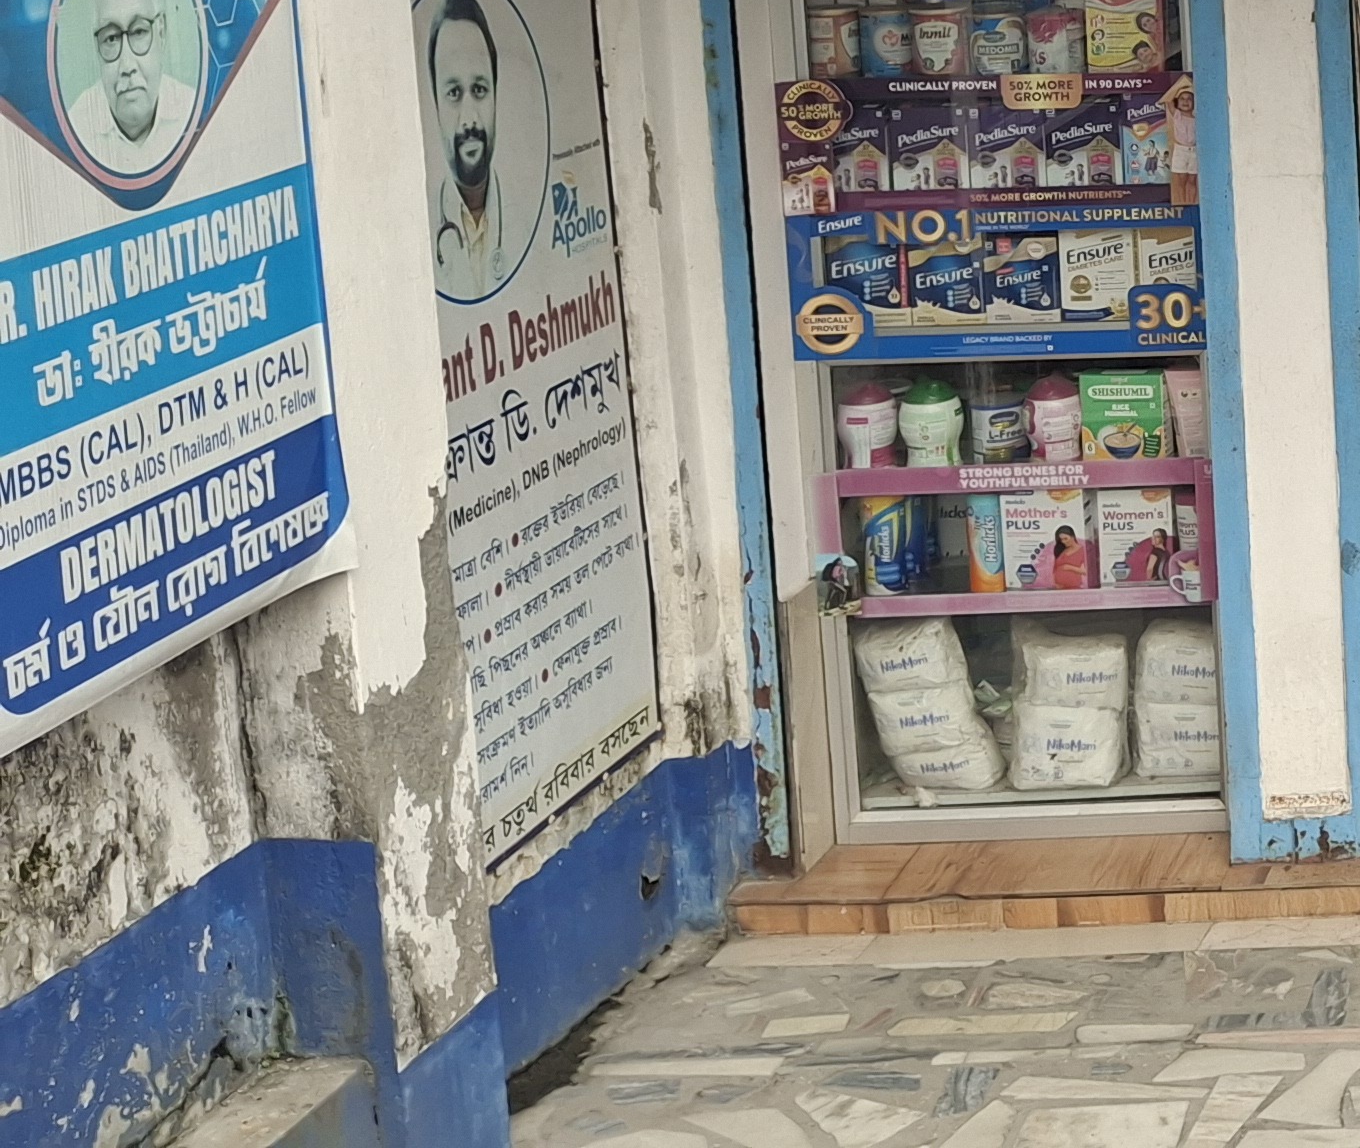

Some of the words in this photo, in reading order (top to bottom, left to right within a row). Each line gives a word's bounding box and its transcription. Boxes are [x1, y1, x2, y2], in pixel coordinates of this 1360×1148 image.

[888, 80, 950, 92] CLINICALLY
[951, 79, 998, 92] PROVEN
[1009, 80, 1033, 91] 50%
[1035, 80, 1074, 91] MORE
[1084, 79, 1098, 89] IN
[1099, 79, 1113, 89] 90
[1013, 91, 1071, 103] GROWTH
[897, 124, 960, 147] PediaSure
[974, 123, 1037, 146] PediaSure
[1051, 121, 1113, 145] PediaSure
[974, 208, 1081, 225] NUTRITIONAL
[1082, 206, 1185, 221] SUPPLEMENT
[551, 204, 607, 259] Apollo
[32, 246, 118, 332] HIRAK
[121, 185, 300, 299] BHATTACHARYA
[830, 253, 897, 280] Ensure
[915, 266, 974, 290] Ensure
[995, 268, 1042, 288] Ensure
[479, 321, 506, 385] D.
[507, 269, 617, 371] Deshmukh
[89, 318, 163, 385] হীরক
[0, 445, 72, 508] MBBS
[80, 412, 153, 478] (CAL),
[158, 385, 208, 436] DTM
[213, 378, 230, 411] &
[234, 367, 249, 404] H
[255, 342, 311, 401] (CAL)
[60, 497, 74, 528] in
[77, 473, 116, 514] STDS
[134, 452, 167, 489] AIDS
[280, 386, 317, 417] Fellow
[522, 459, 551, 492] DNB
[552, 416, 627, 478] (Nephrology)
[958, 468, 1012, 480] STRONG
[1013, 466, 1057, 478] BONES
[1058, 464, 1084, 475] FOR
[959, 476, 1028, 489] YOUTHFUL
[1028, 475, 1089, 487] MOBILITY
[1005, 506, 1068, 519] Mother's
[1101, 507, 1165, 521] Women's
[60, 449, 278, 604] DERMATOLOGIST
[1005, 519, 1041, 531] PLUS
[1102, 521, 1135, 532] PLUS
[985, 515, 998, 563] Horlicks
[57, 620, 88, 672] ও
[165, 544, 229, 618] রোগ
